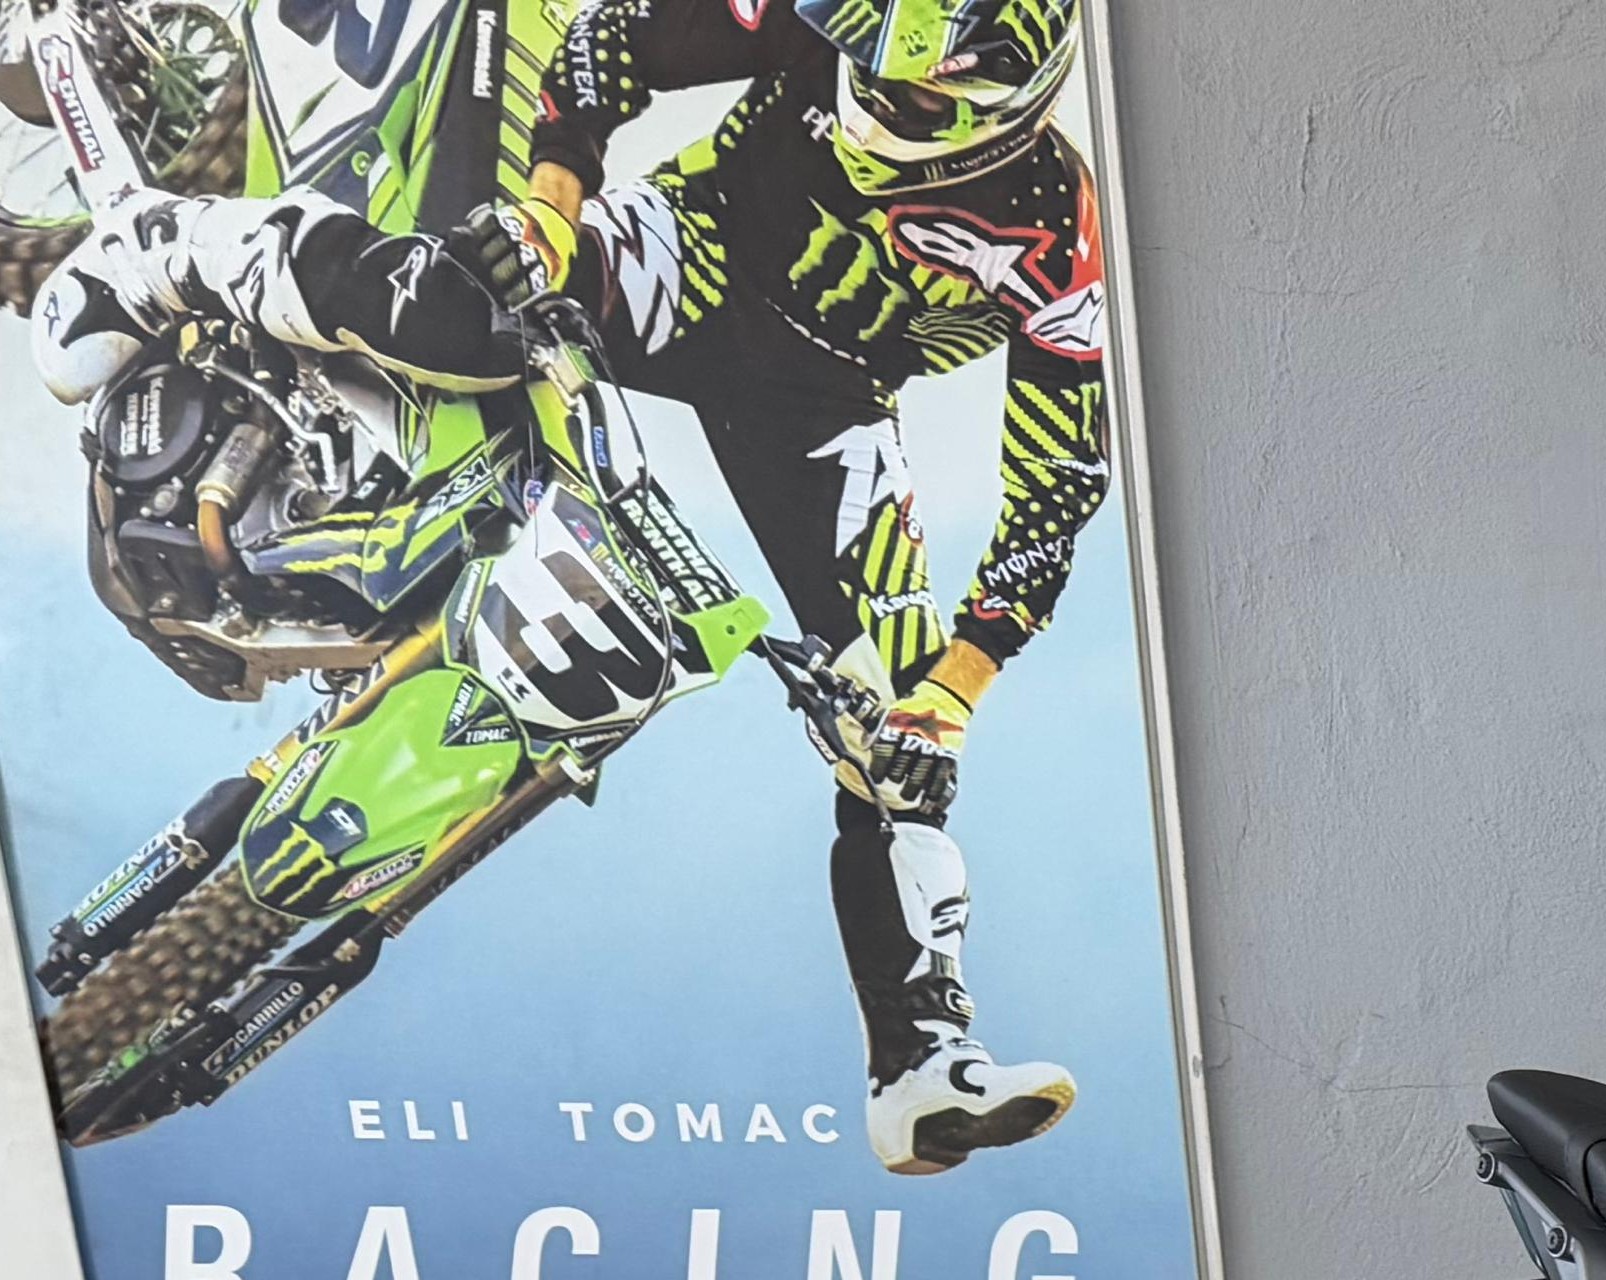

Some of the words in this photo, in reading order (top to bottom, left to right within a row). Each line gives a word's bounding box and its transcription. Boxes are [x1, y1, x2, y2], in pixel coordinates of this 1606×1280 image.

[465, 728, 511, 745] TOMAC
[83, 873, 154, 938] CARRILLO
[235, 981, 304, 1044] CARRILLO
[348, 1099, 470, 1141] ELI
[559, 1100, 842, 1144] TOMAC
